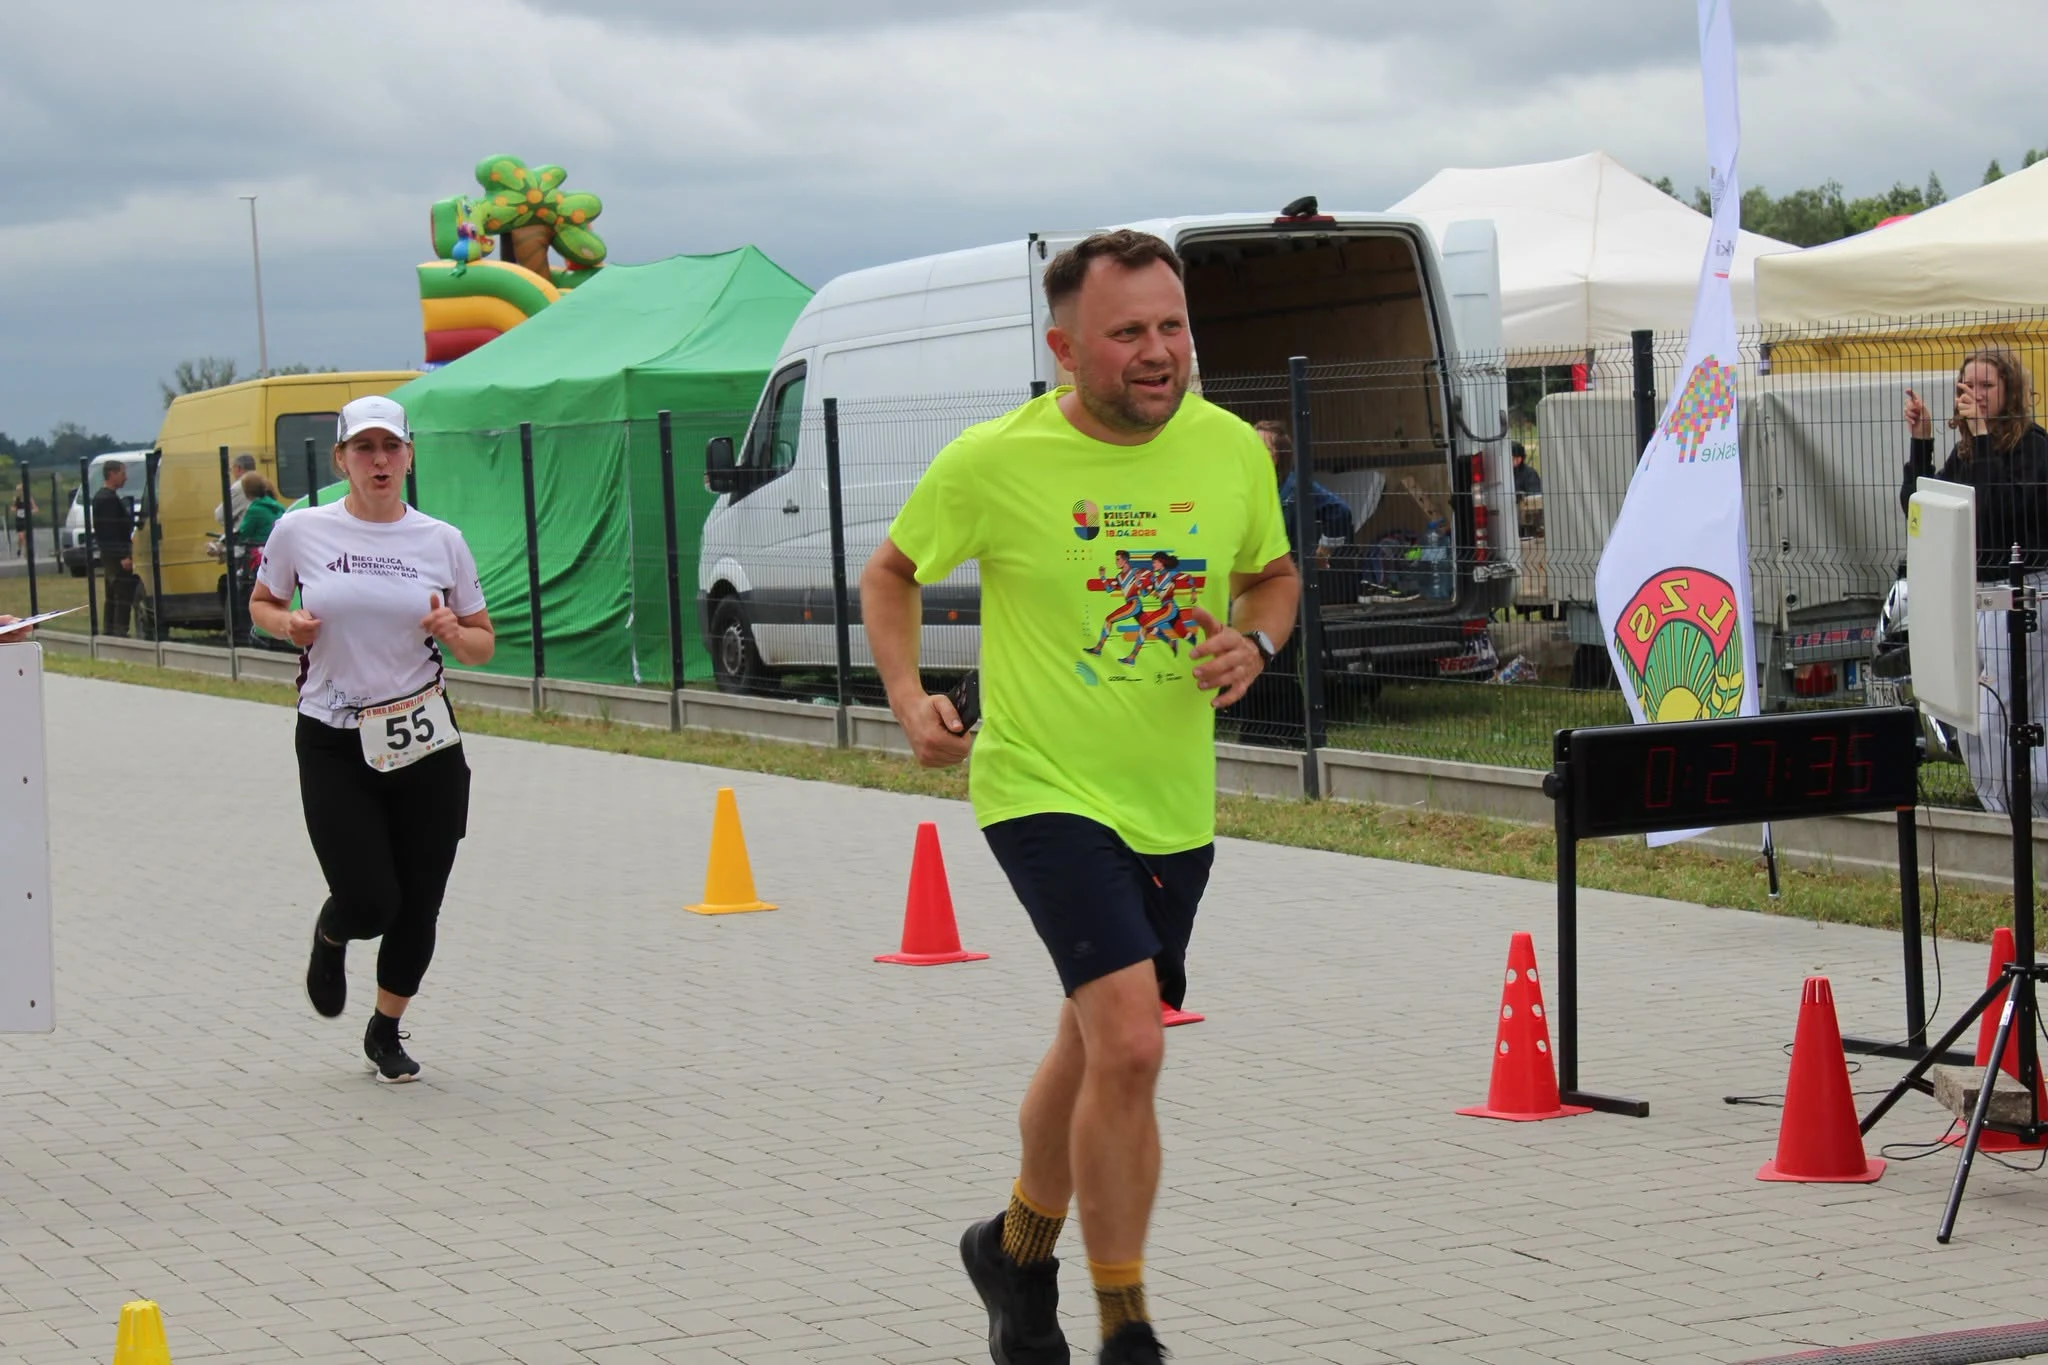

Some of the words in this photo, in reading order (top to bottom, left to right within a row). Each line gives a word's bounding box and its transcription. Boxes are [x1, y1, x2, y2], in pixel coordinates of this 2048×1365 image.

[351, 562, 418, 574] PIOTRKOWSKA
[375, 557, 403, 566] ULICA
[386, 705, 434, 750] 55
[1644, 733, 1875, 808] 0:27:35
